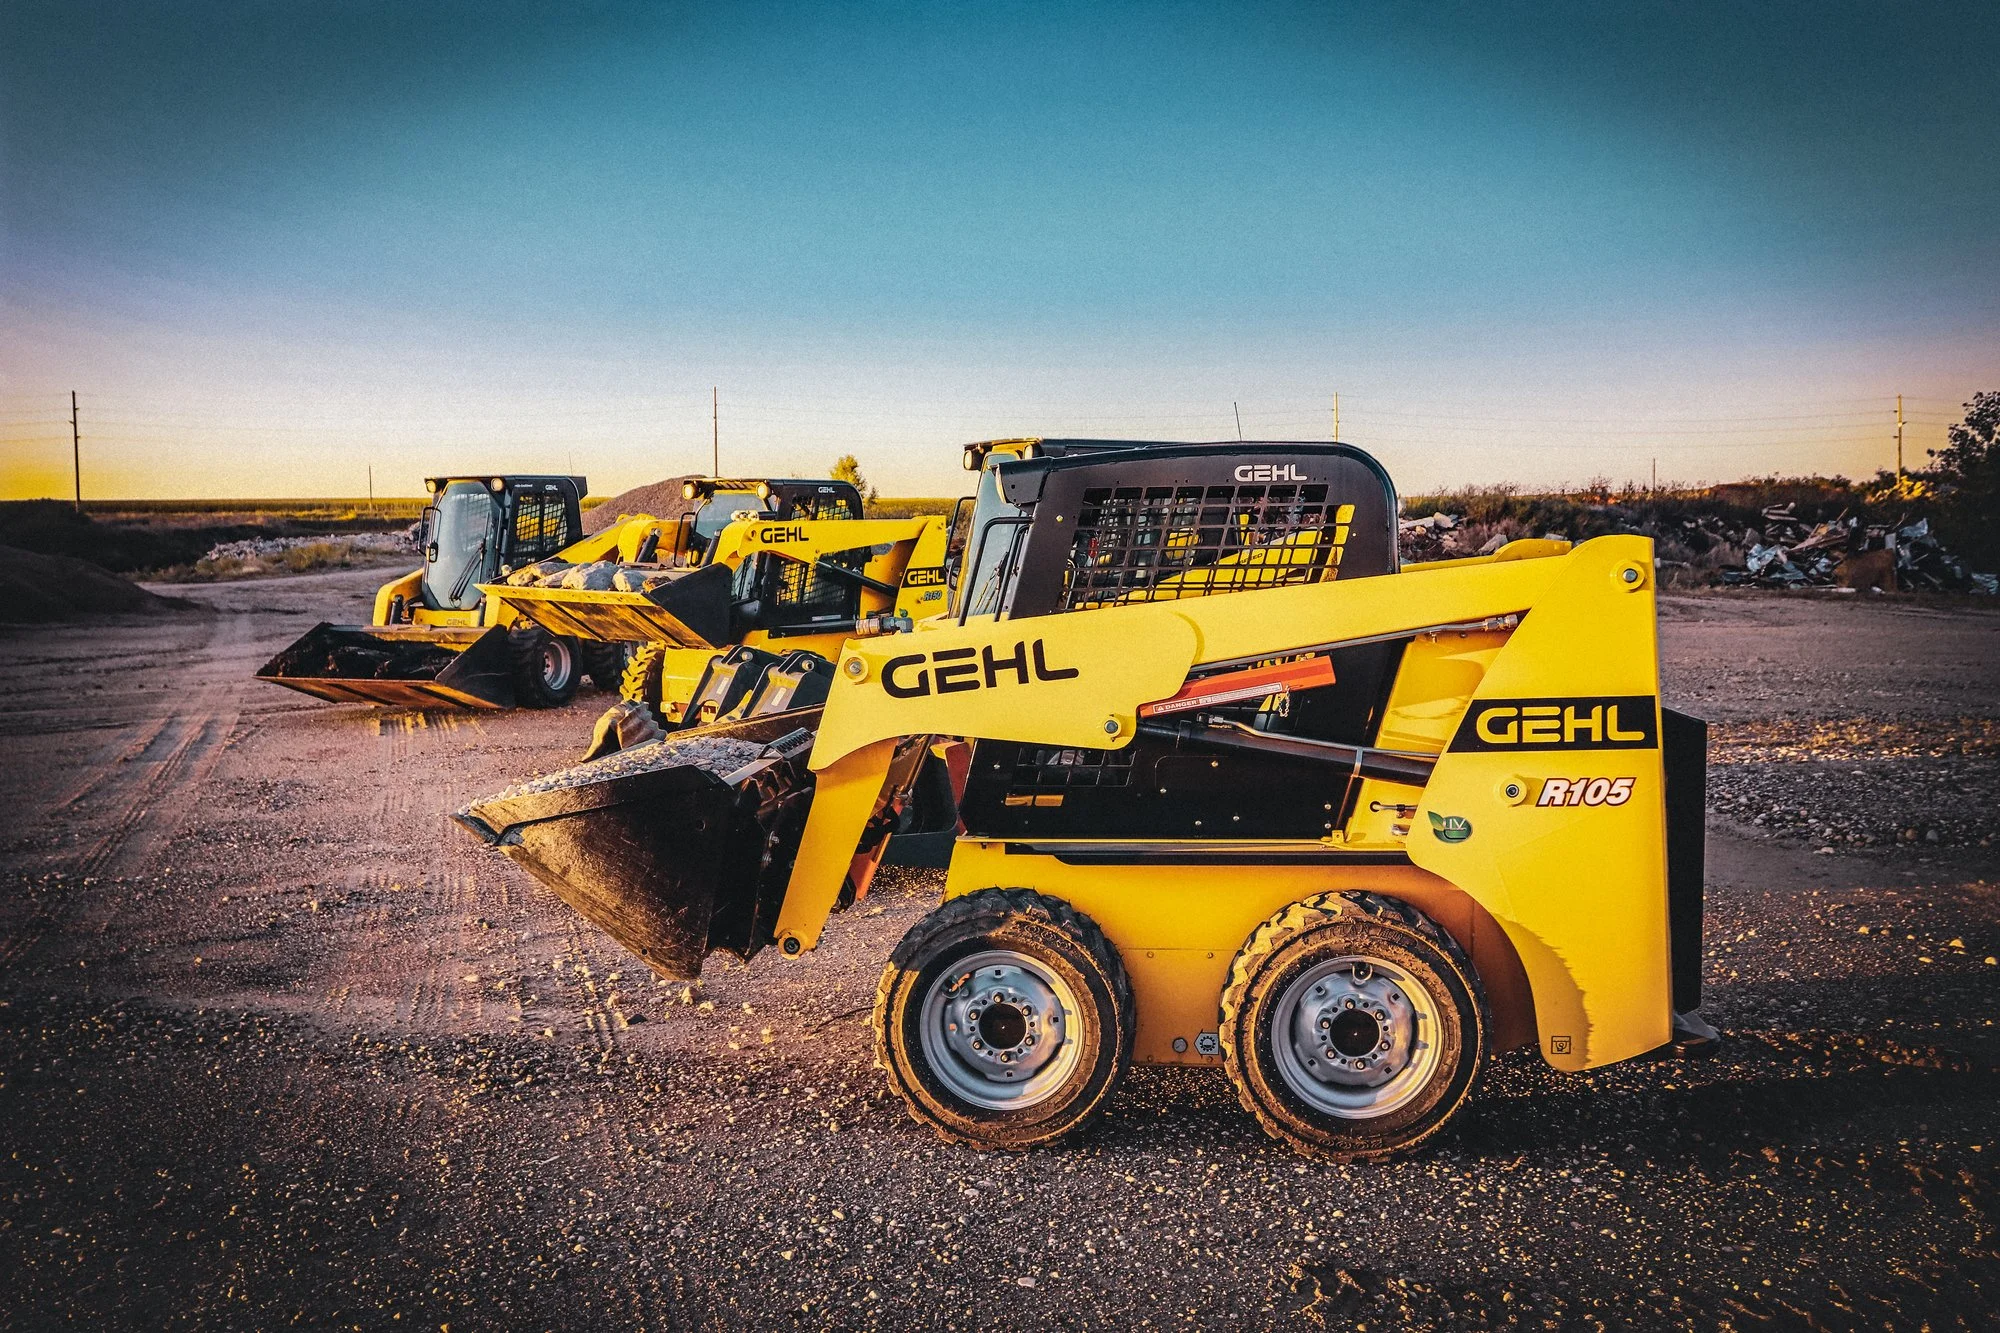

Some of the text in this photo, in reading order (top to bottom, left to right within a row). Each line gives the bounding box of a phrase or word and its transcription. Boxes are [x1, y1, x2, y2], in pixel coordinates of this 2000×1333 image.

[1234, 464, 1308, 482] GEHL
[818, 486, 836, 494] GEHL
[760, 526, 810, 544] GEHL
[907, 569, 945, 585] GEHL
[922, 589, 943, 602] R150
[881, 638, 1080, 699] GEHL
[1165, 699, 1198, 710] DANGER
[1476, 704, 1646, 744] GEHL
[1535, 777, 1637, 807] R105
